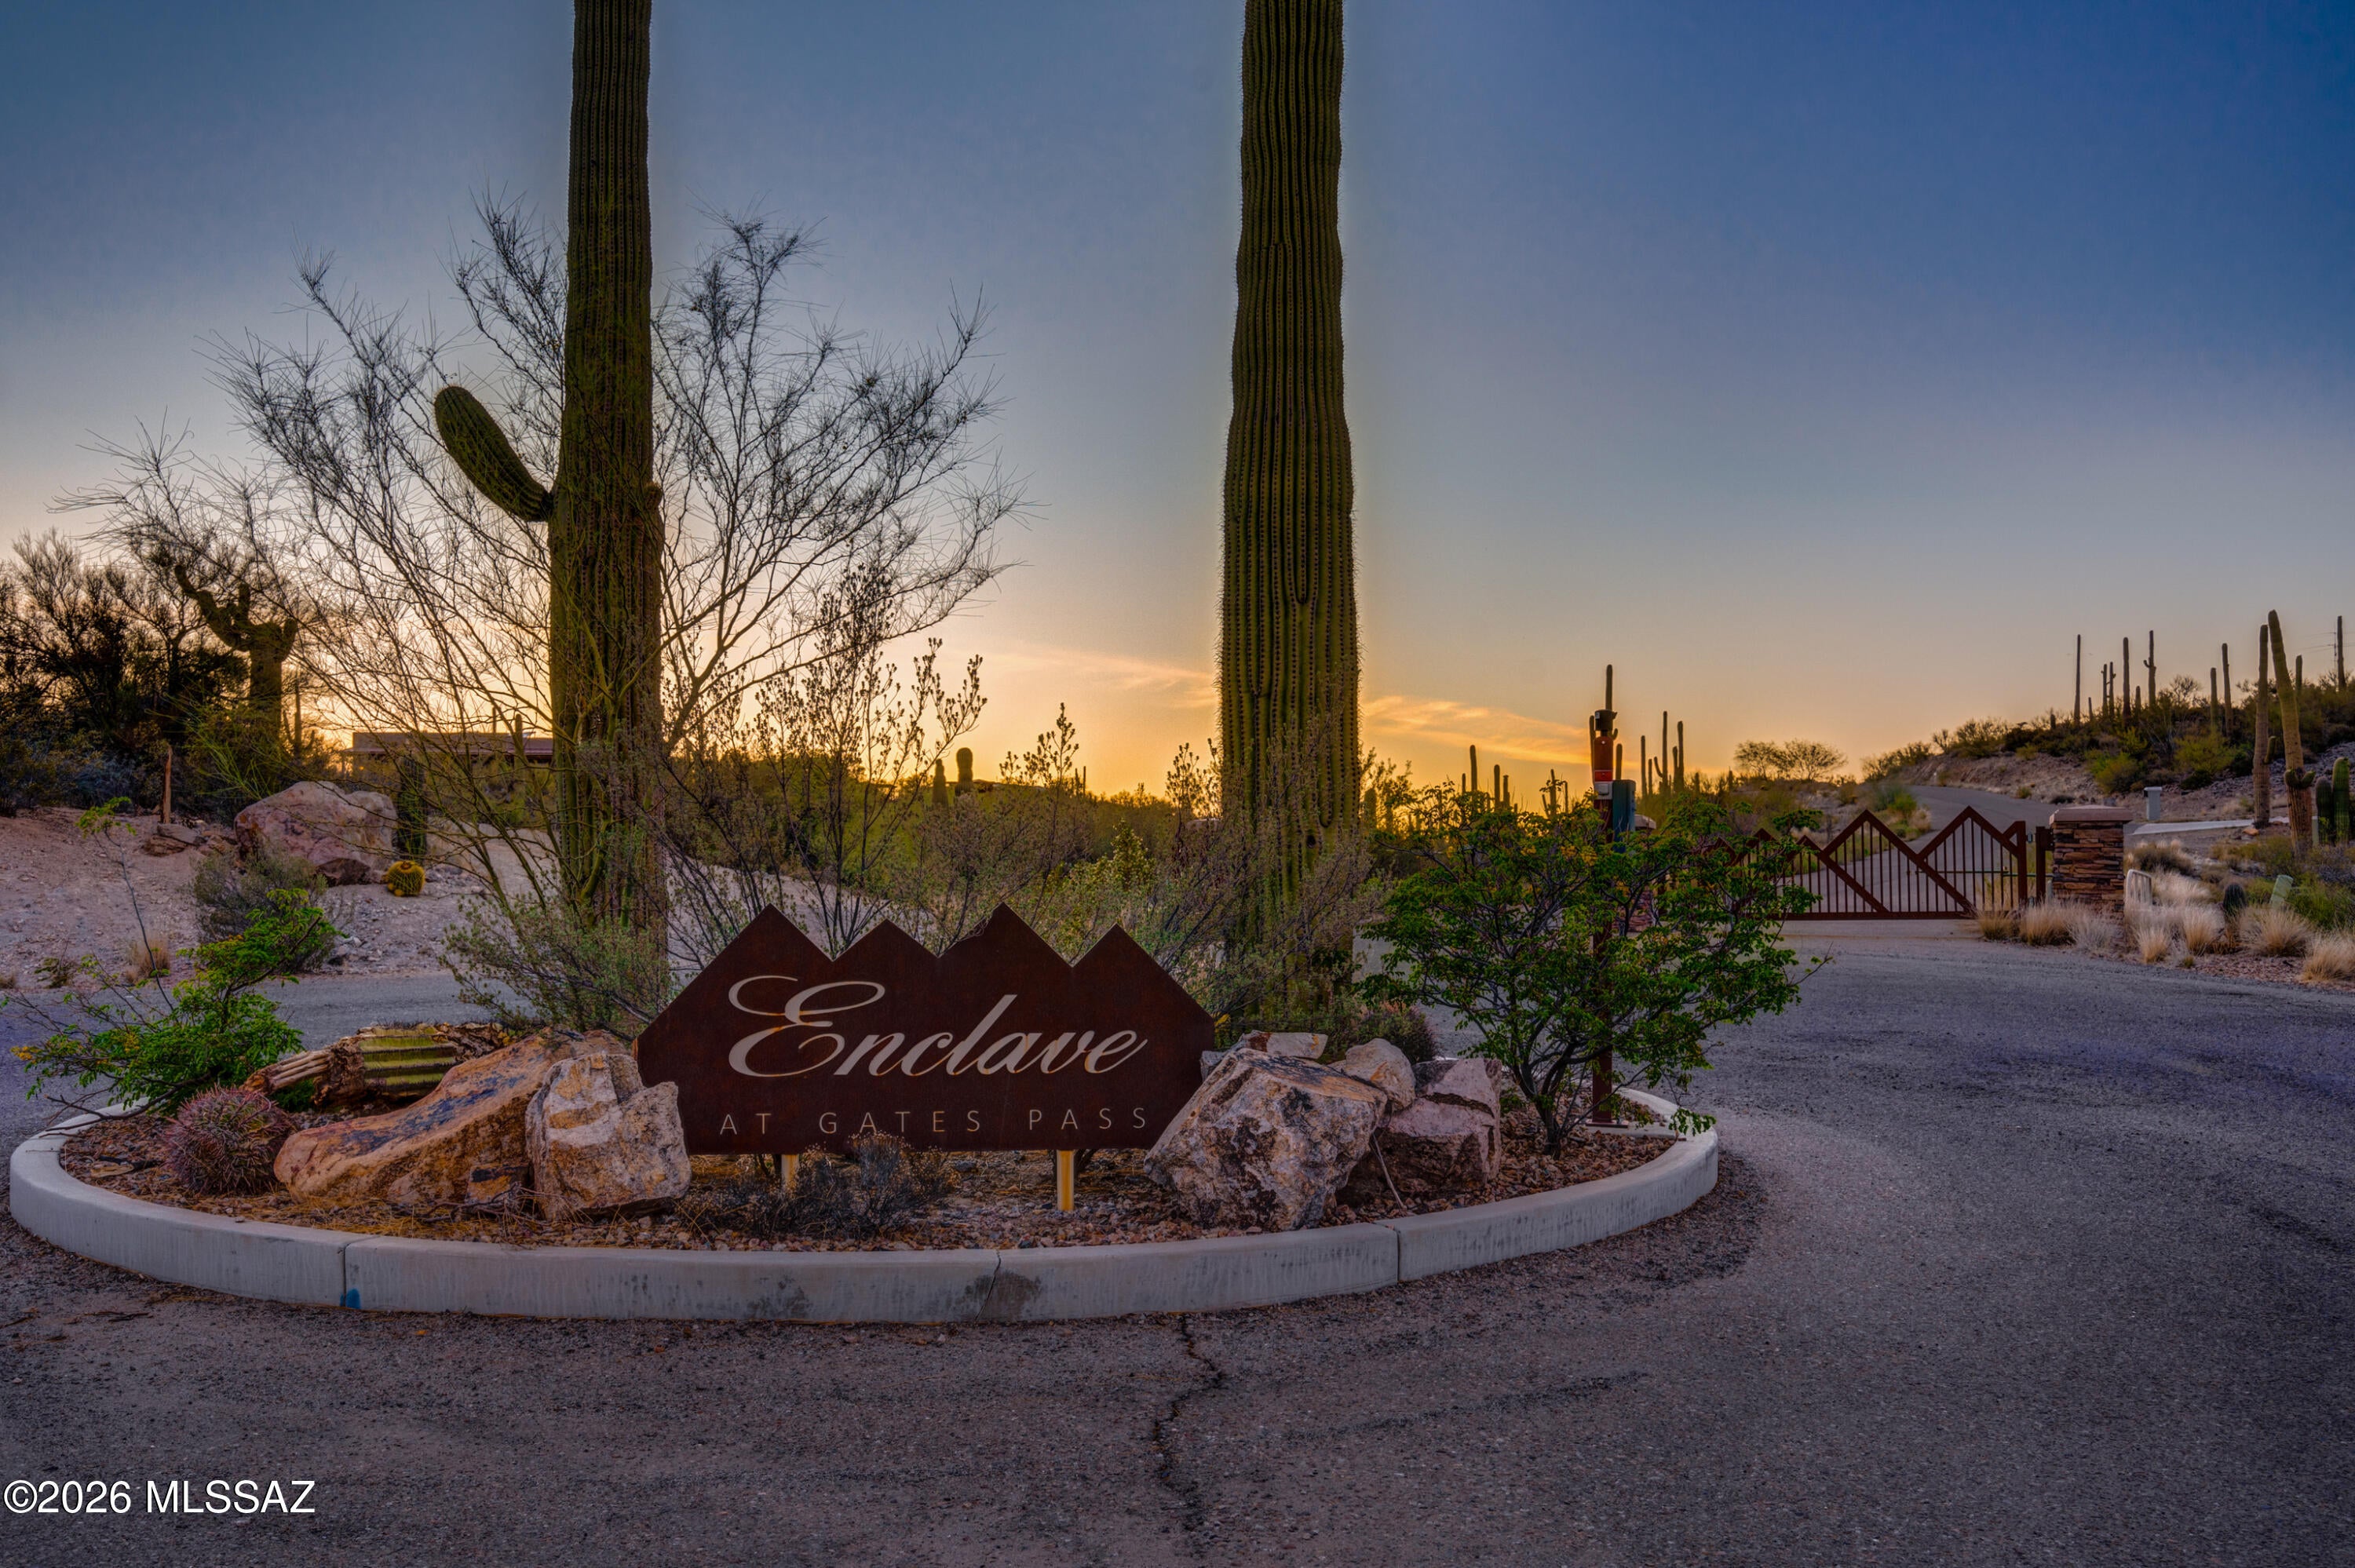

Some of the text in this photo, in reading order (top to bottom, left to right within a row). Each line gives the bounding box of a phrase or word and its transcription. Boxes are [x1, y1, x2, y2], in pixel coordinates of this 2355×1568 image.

[728, 975, 1148, 1078] Enclave
[720, 1107, 1146, 1135] AT GATES PASS
